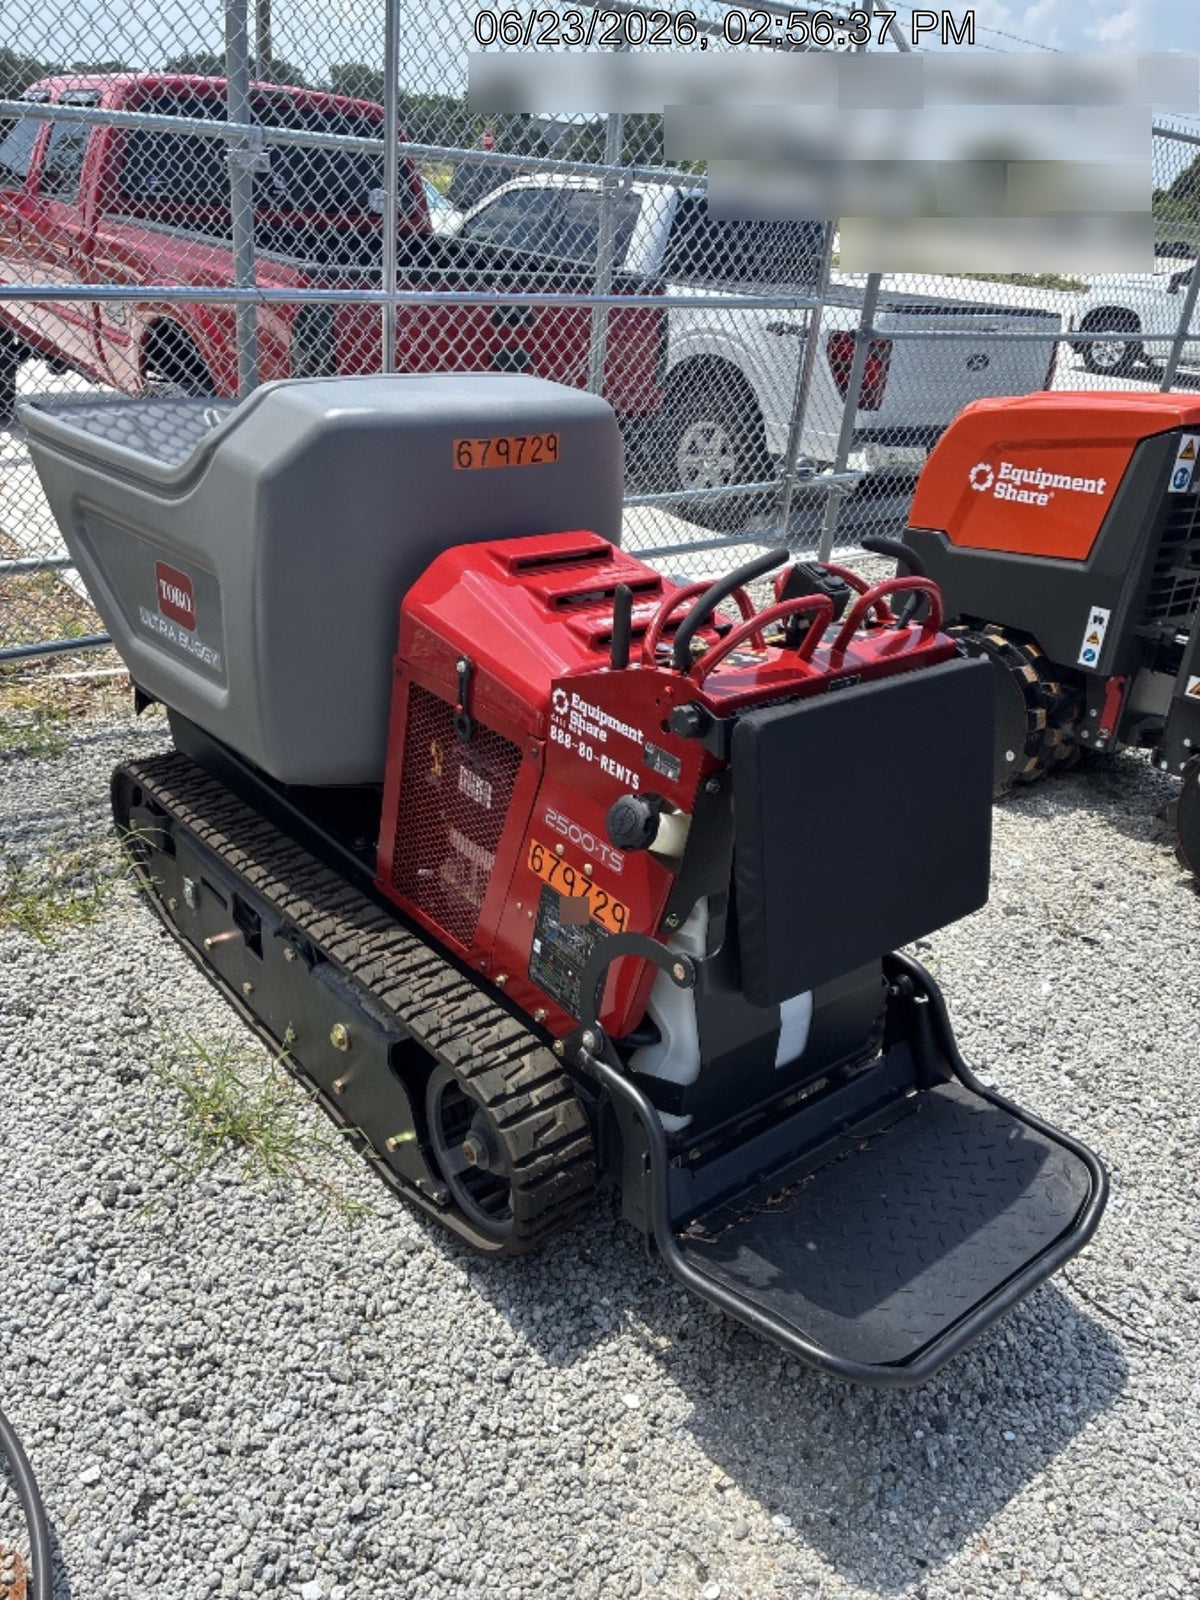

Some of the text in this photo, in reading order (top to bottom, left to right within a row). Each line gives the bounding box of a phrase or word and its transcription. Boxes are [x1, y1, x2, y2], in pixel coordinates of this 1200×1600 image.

[456, 434, 558, 468] 679729
[998, 461, 1107, 495] Equipment
[159, 579, 192, 612] TORO
[139, 606, 219, 665] ULTRA BUGGY
[569, 710, 608, 742] Share
[570, 692, 644, 745] Equipment
[550, 724, 640, 790] 888-80-RENTS
[530, 843, 626, 932] 679729
